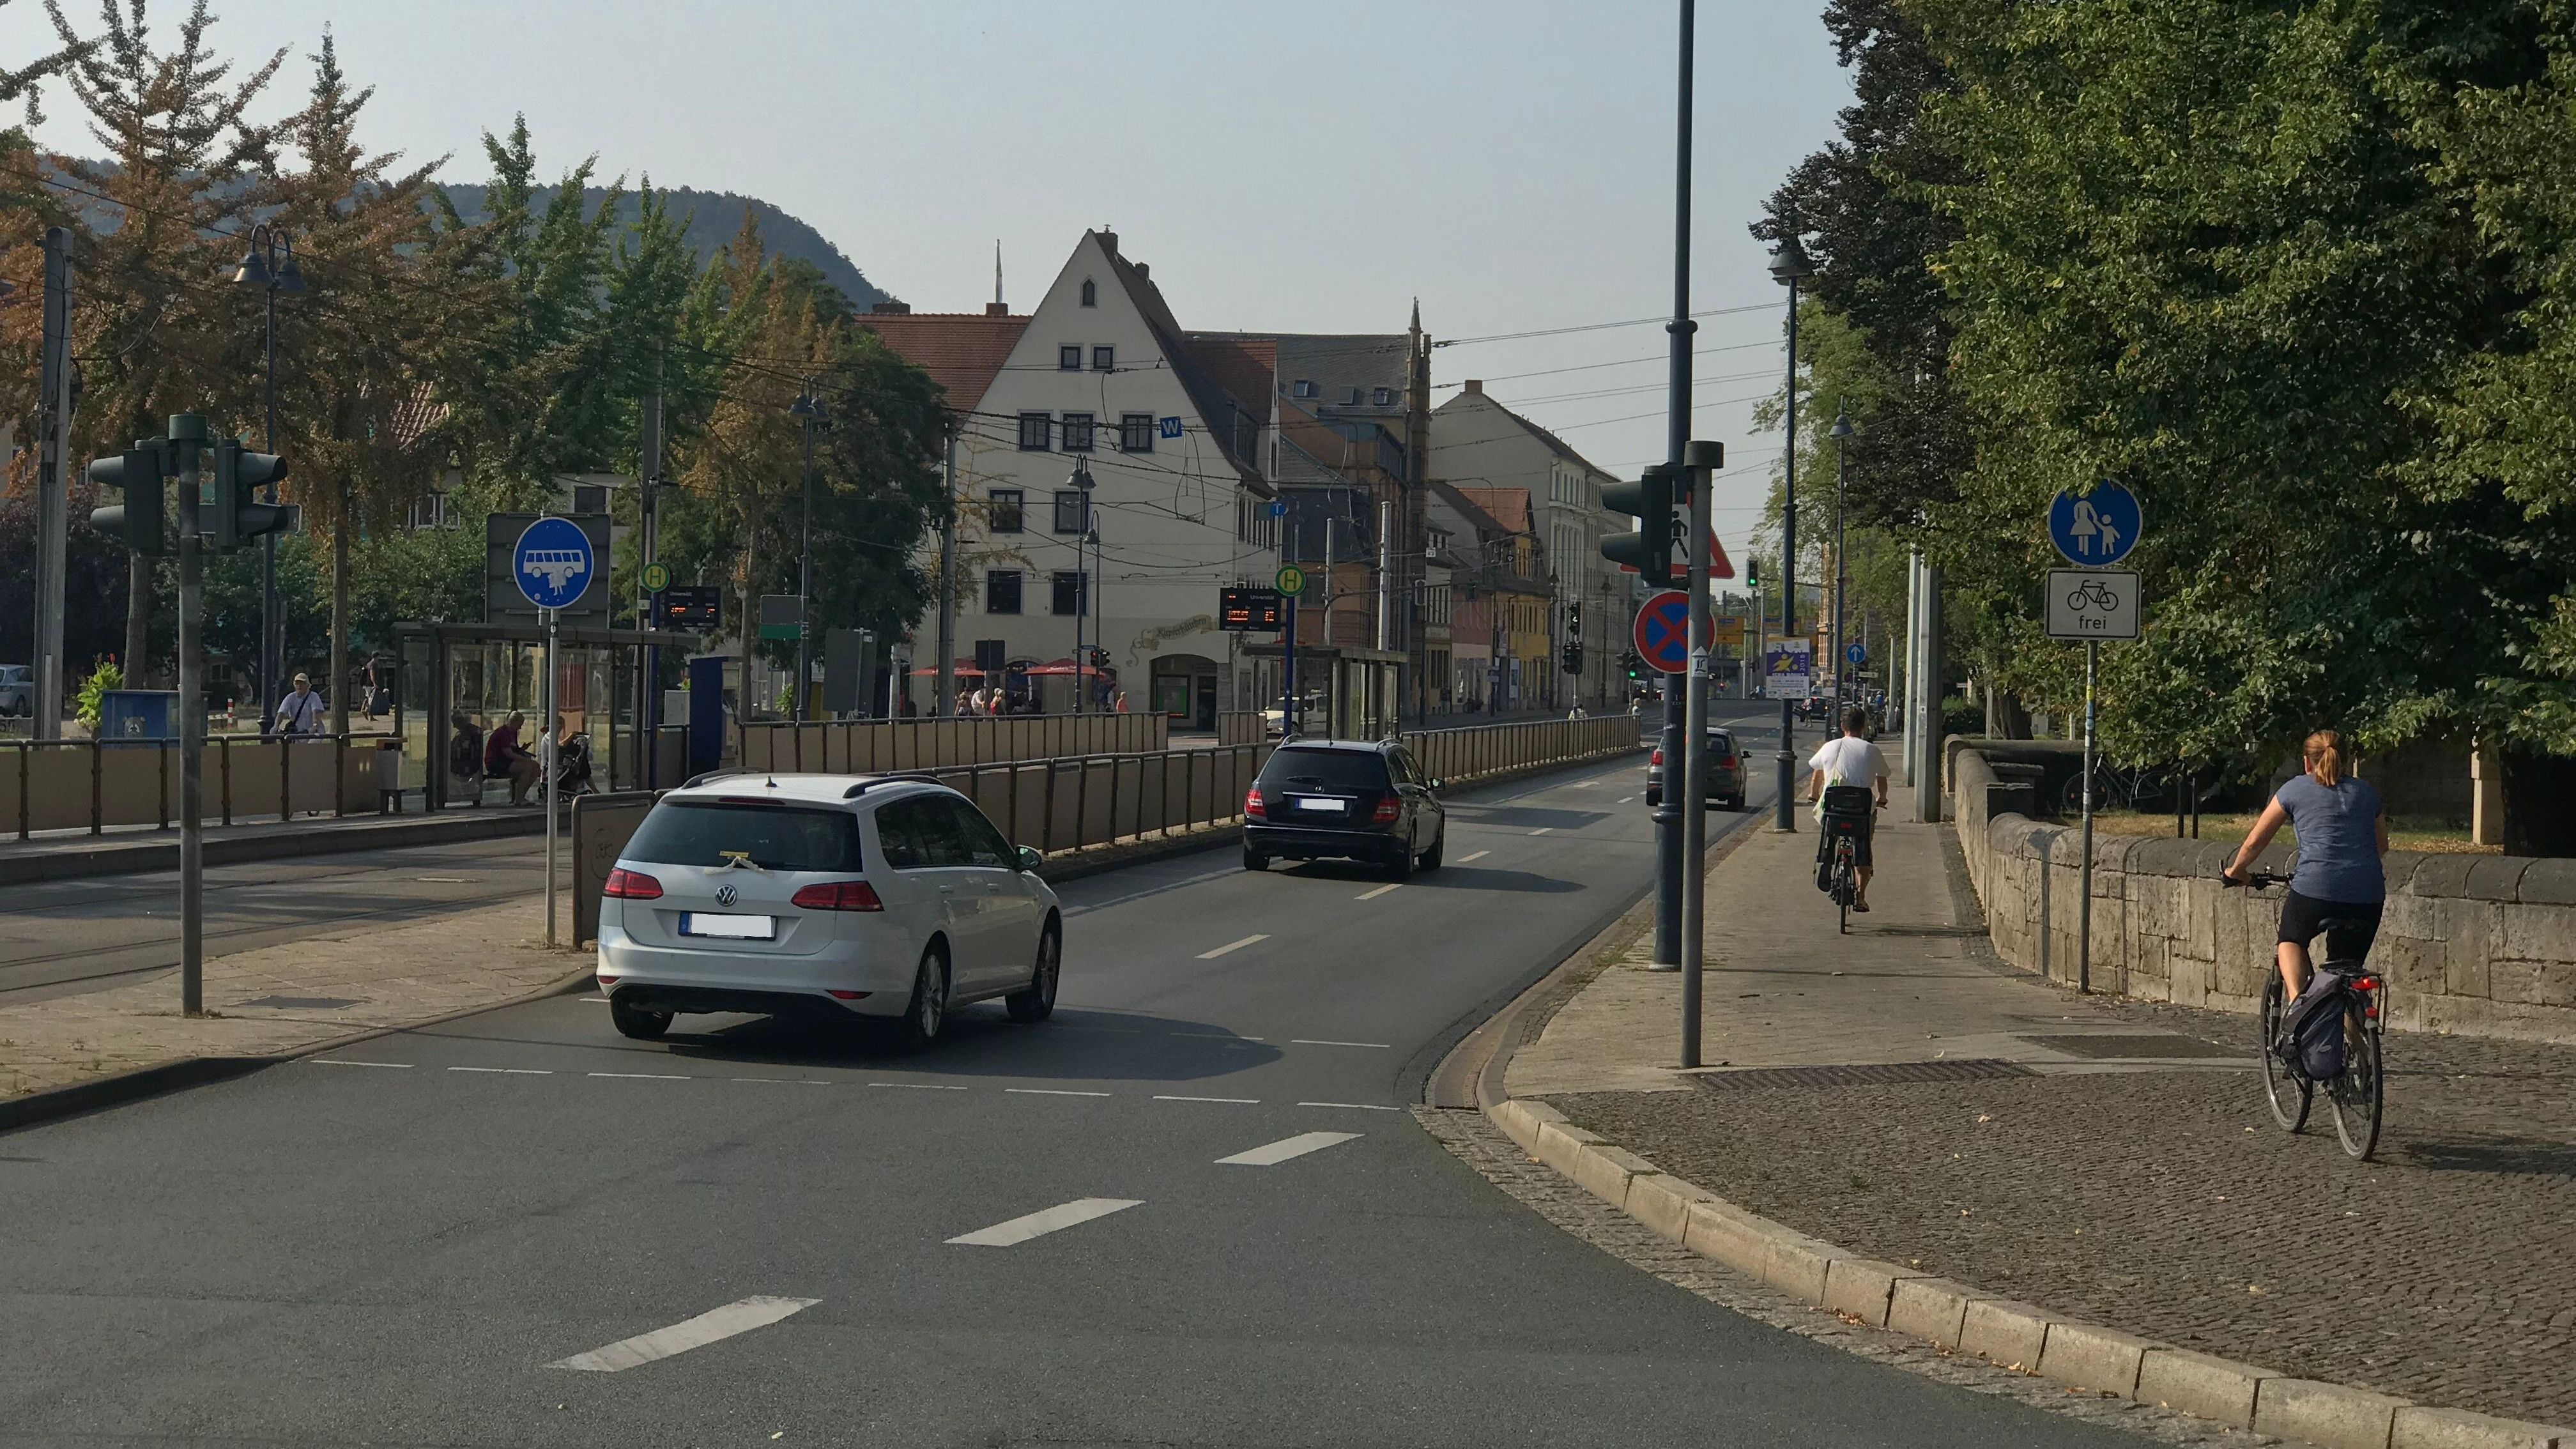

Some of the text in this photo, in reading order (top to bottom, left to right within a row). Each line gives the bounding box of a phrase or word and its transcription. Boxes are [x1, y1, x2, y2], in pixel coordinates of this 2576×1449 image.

[1162, 419, 1179, 434] W
[649, 568, 661, 585] H
[1284, 572, 1298, 589] H
[2079, 615, 2106, 629] frei
